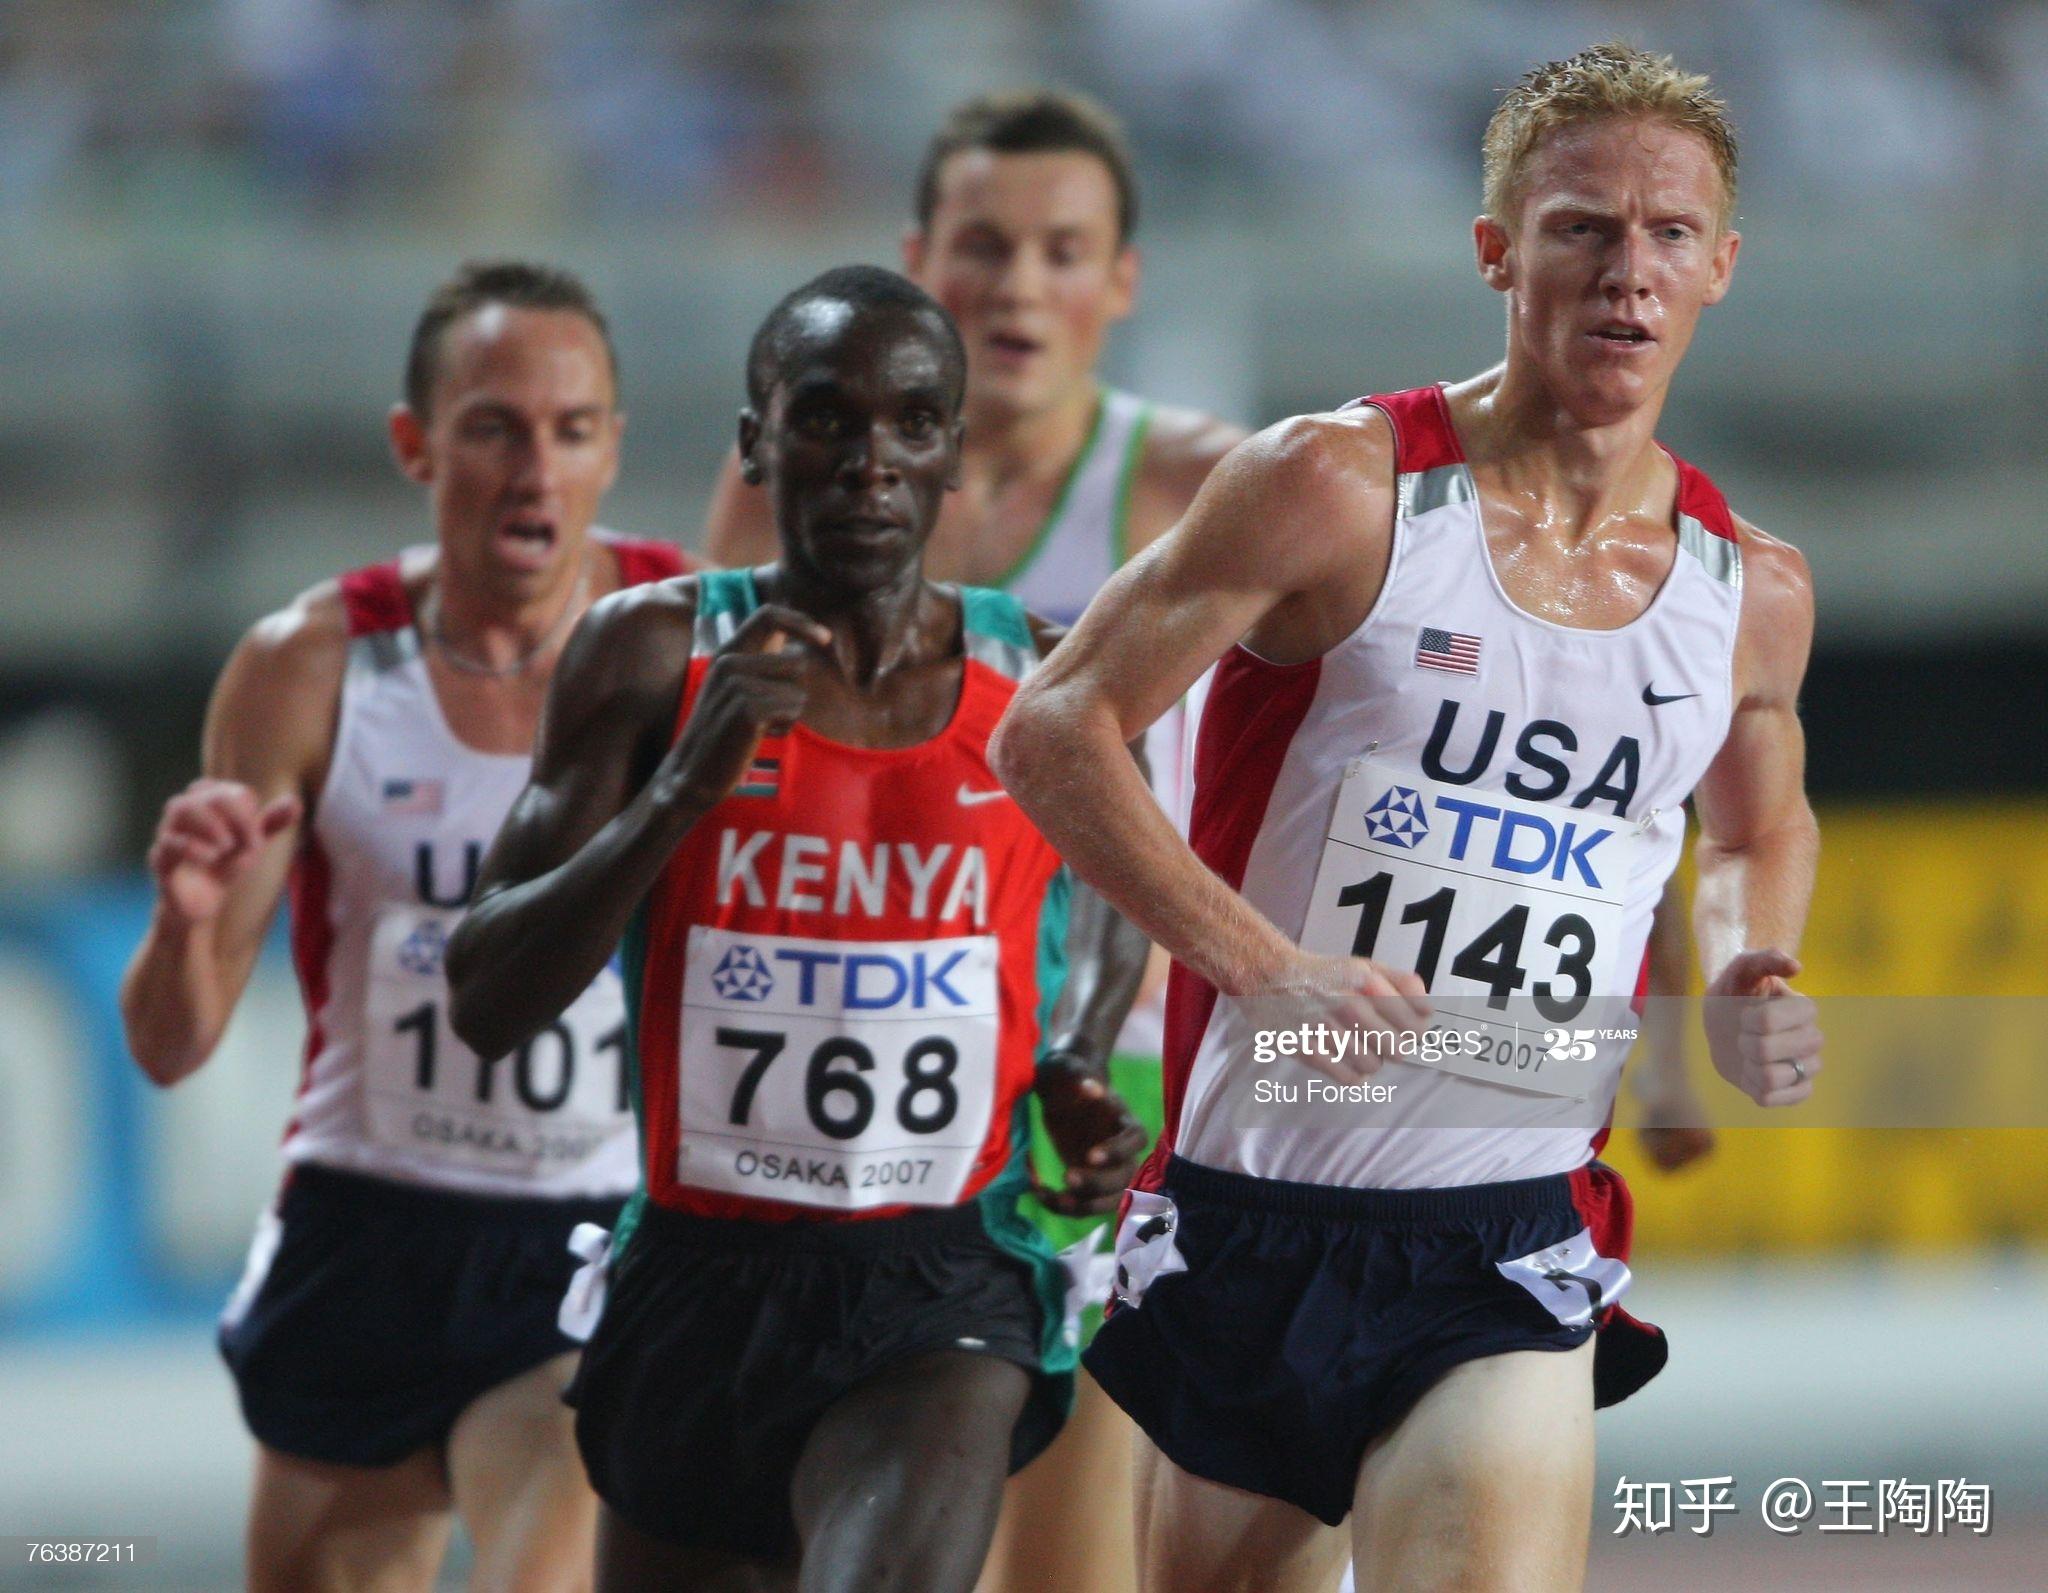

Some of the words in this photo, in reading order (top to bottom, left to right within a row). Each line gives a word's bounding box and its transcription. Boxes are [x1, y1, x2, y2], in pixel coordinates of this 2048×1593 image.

[1421, 699, 1640, 818] USA
[716, 828, 987, 927] KENYA
[1434, 796, 1614, 889] TDK
[775, 949, 970, 1010] TDK
[1337, 871, 1596, 1023] 1143
[715, 1026, 959, 1140] 768
[1474, 1035, 1551, 1072] 2007
[735, 1149, 849, 1189] OSAKA
[861, 1160, 933, 1188] 2007
